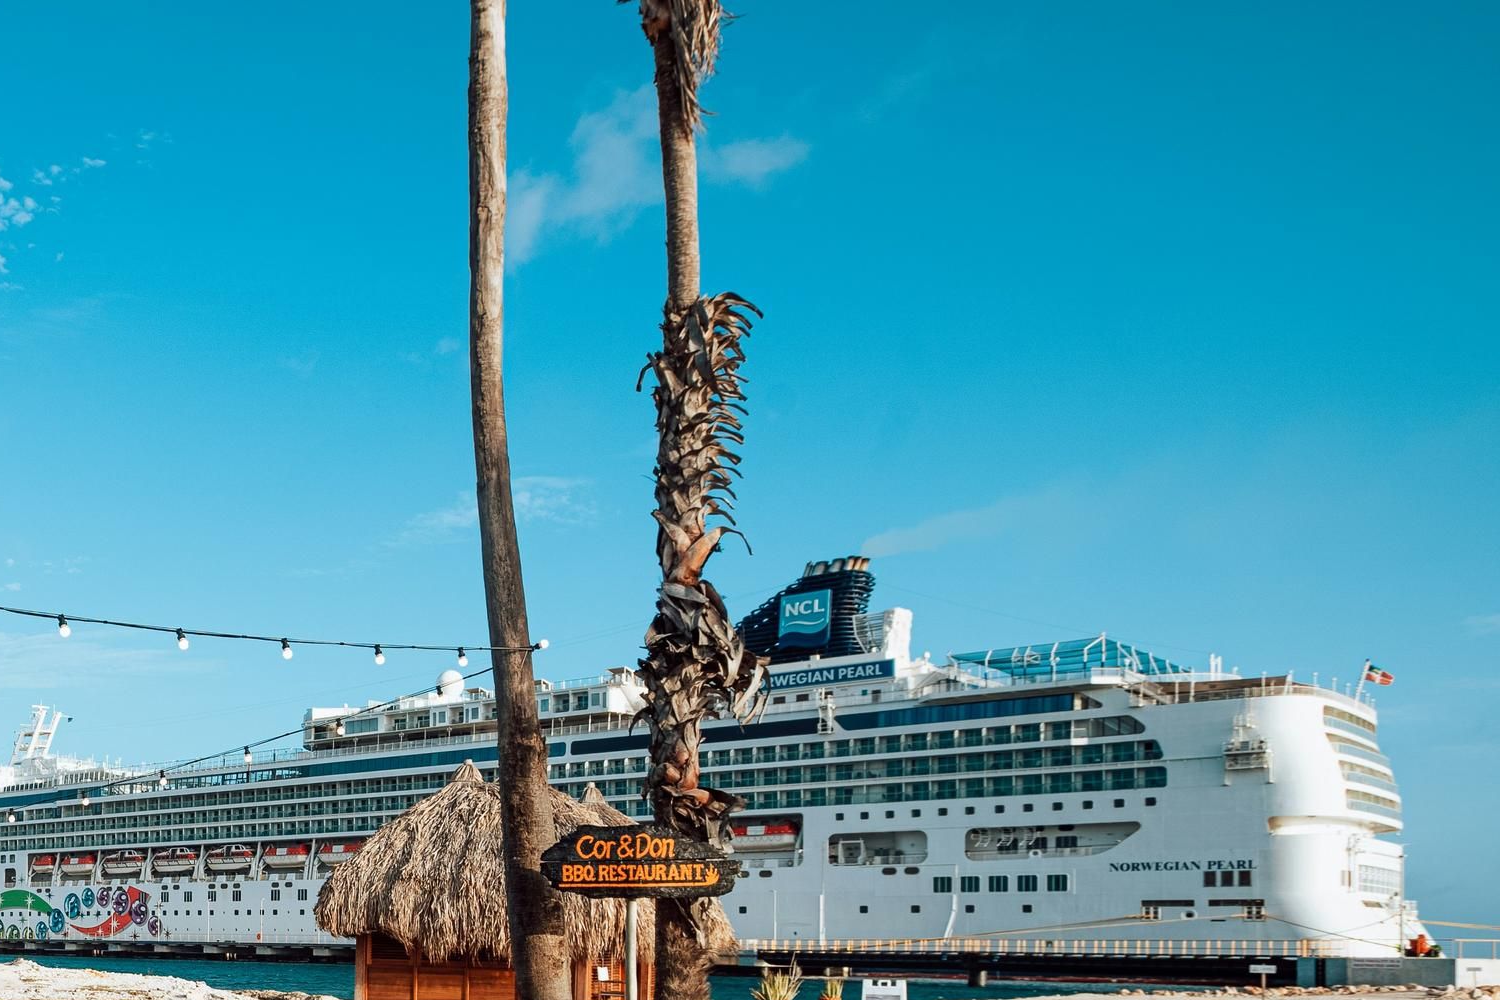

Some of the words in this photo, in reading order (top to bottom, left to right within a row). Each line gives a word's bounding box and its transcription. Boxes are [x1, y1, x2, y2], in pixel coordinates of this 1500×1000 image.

[785, 599, 825, 617] NCL
[760, 671, 834, 688] RWEGIAN
[838, 664, 882, 679] PEARL
[562, 864, 596, 882] BBQ
[598, 864, 705, 881] RESTAURANT
[1109, 860, 1201, 872] NORWEGIAN
[1207, 859, 1257, 870] PEARL
